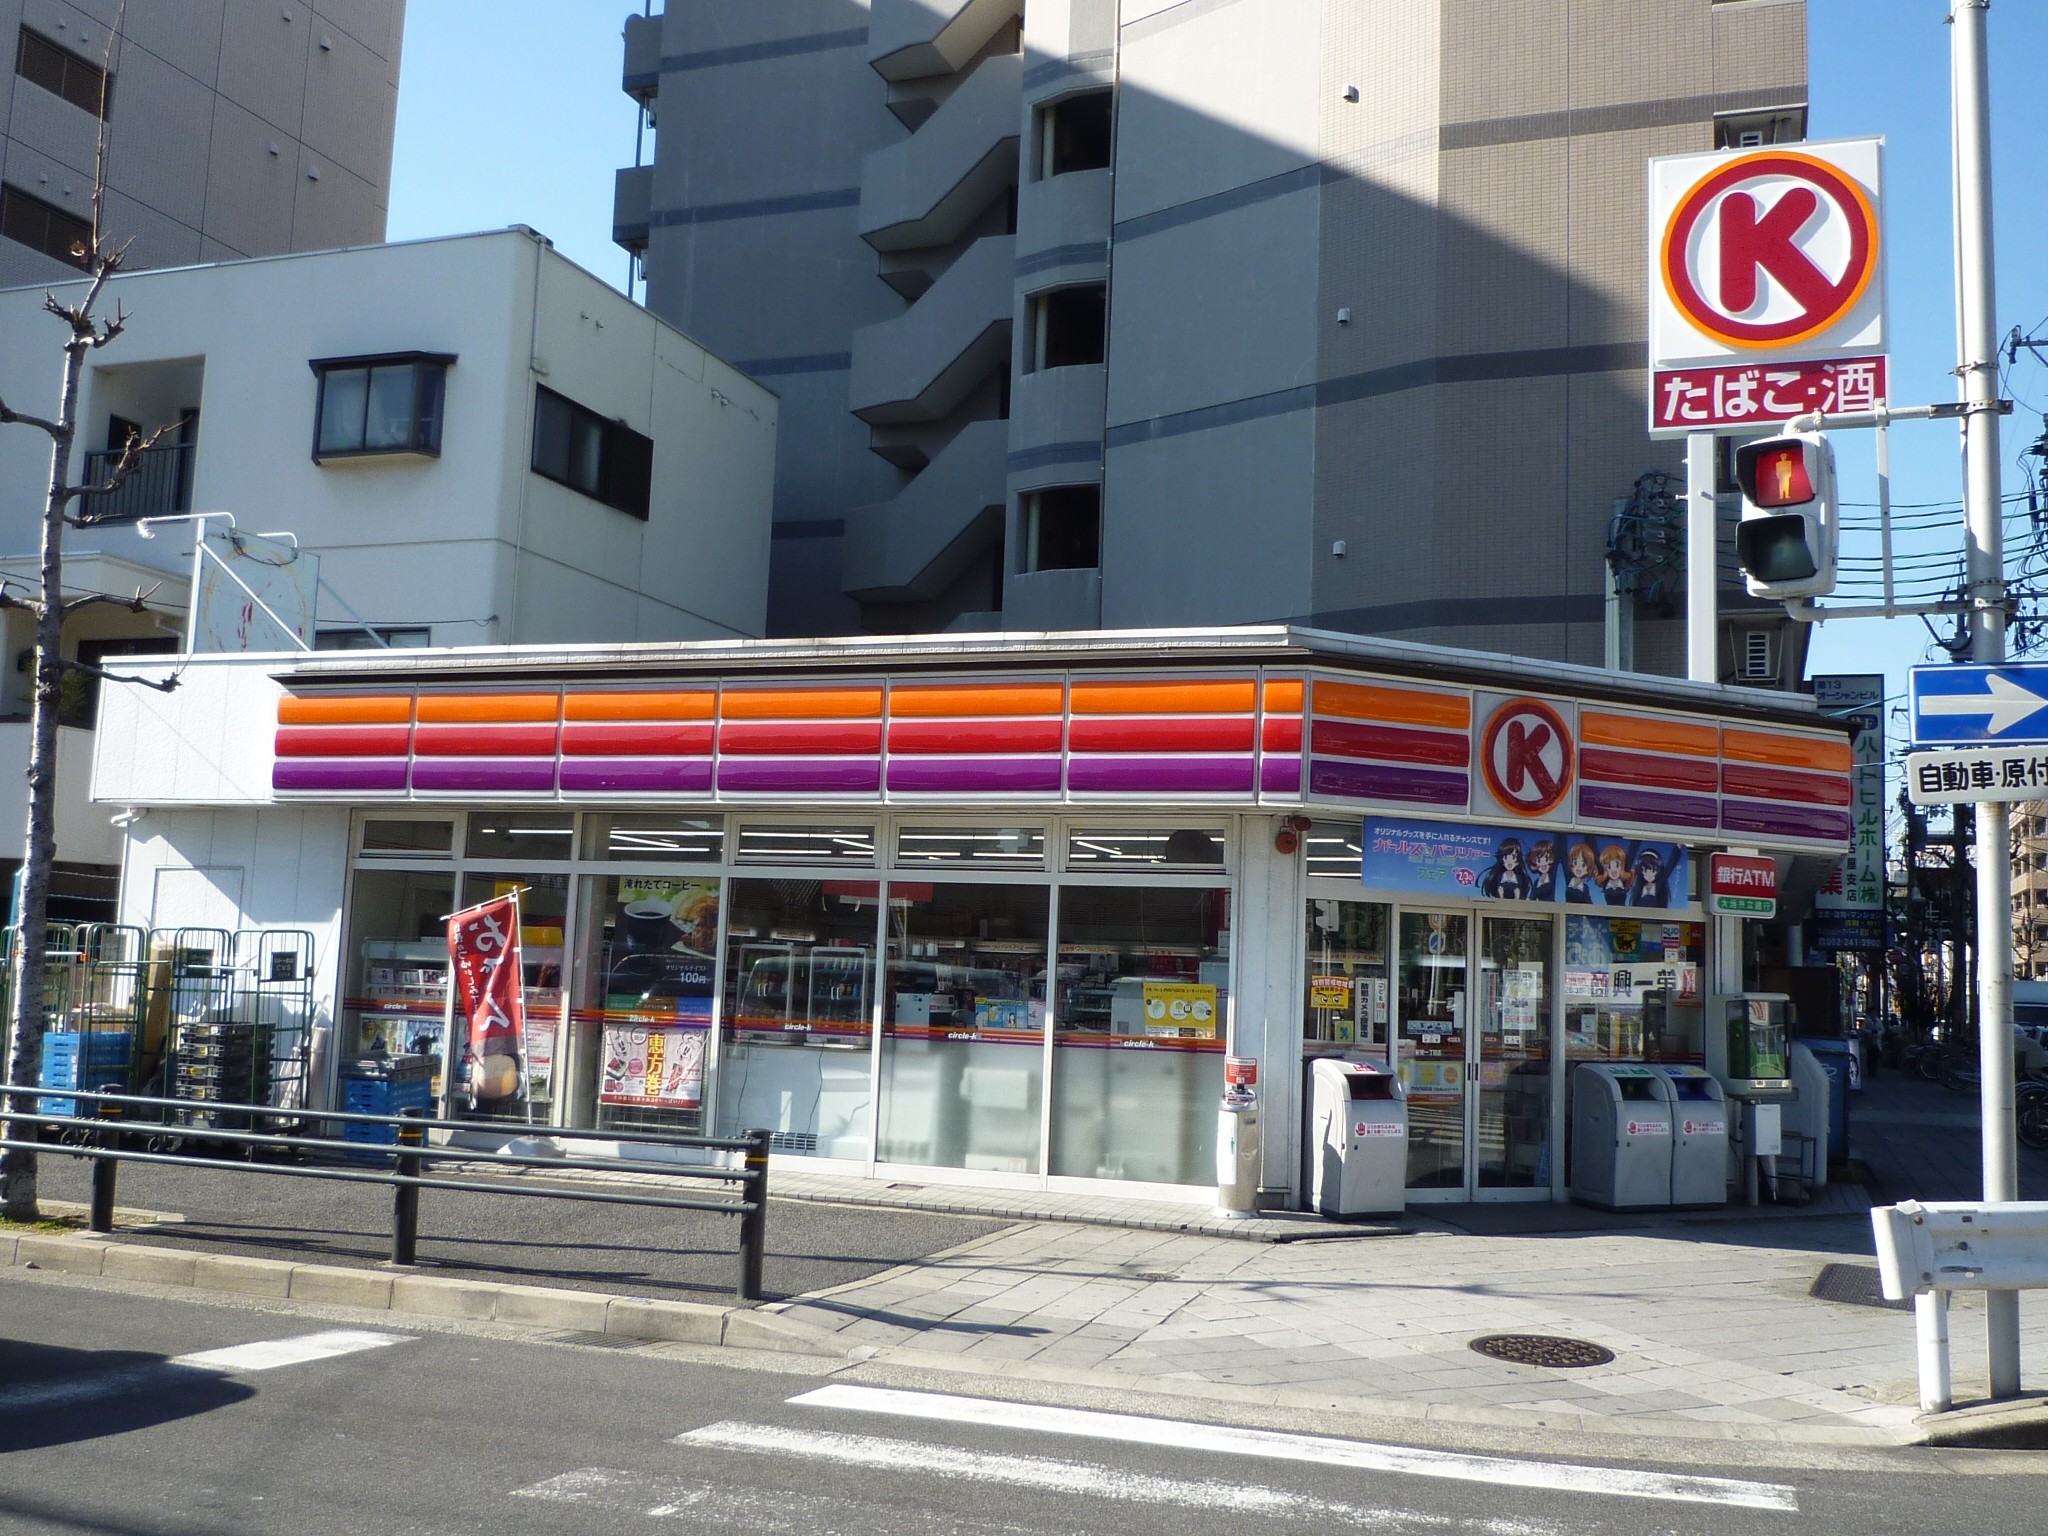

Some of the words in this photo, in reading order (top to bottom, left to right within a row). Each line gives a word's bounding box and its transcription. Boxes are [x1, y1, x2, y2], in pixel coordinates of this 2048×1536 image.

[1663, 361, 1877, 421] たばこ・酒
[1817, 690, 1879, 700] オーシャンビル
[1716, 866, 1775, 887] 銀行ATM
[1663, 926, 1679, 937] QUO
[680, 972, 707, 984] 100円
[785, 1023, 812, 1031] circle-k
[948, 1031, 978, 1041] circle-k
[1124, 1039, 1156, 1048] circle-k
[645, 1034, 666, 1094] 恵方巻
